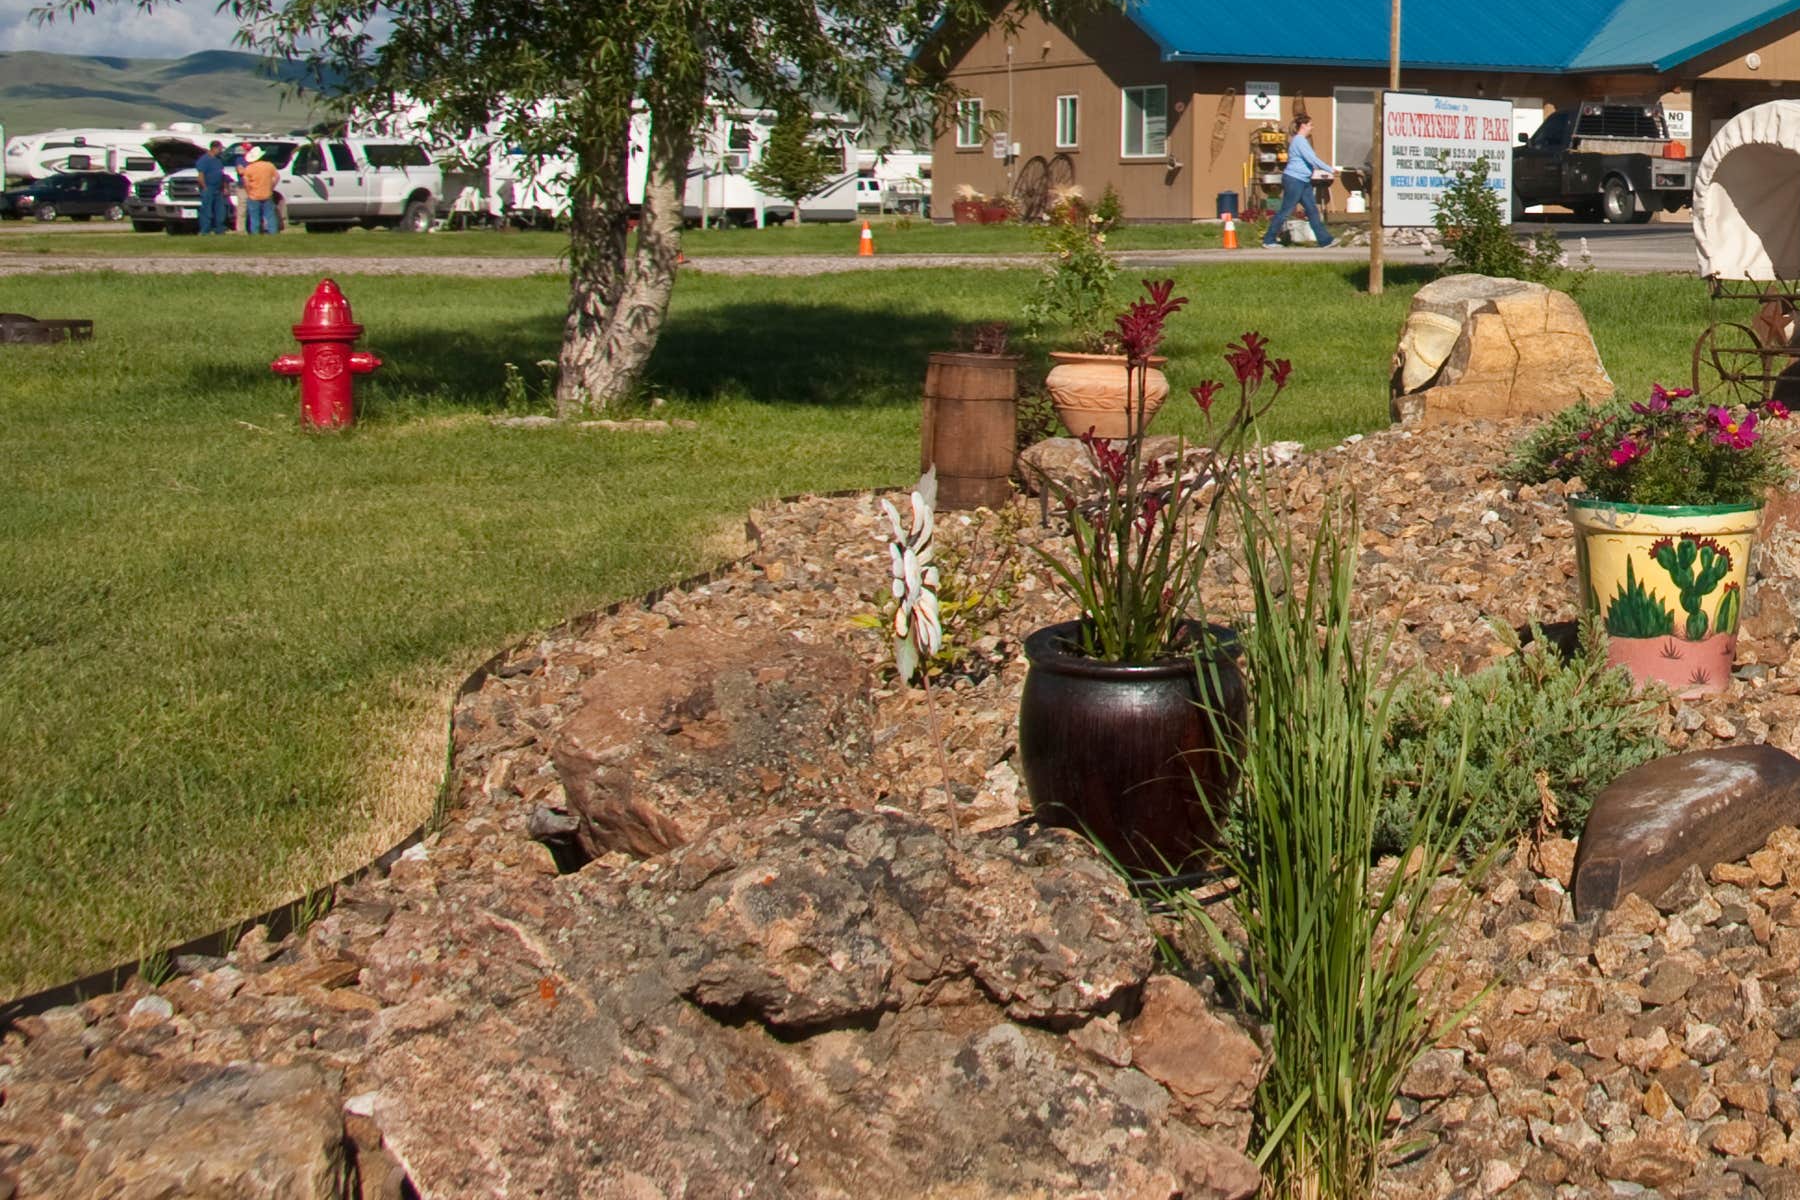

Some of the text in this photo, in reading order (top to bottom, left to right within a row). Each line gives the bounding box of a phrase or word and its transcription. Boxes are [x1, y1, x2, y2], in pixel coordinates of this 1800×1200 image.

[1668, 112, 1684, 121] NO
[1387, 111, 1509, 142] COUNTRYSIDE RV PARK
[1390, 175, 1414, 188] WEEKLY
[1416, 176, 1428, 188] AND
